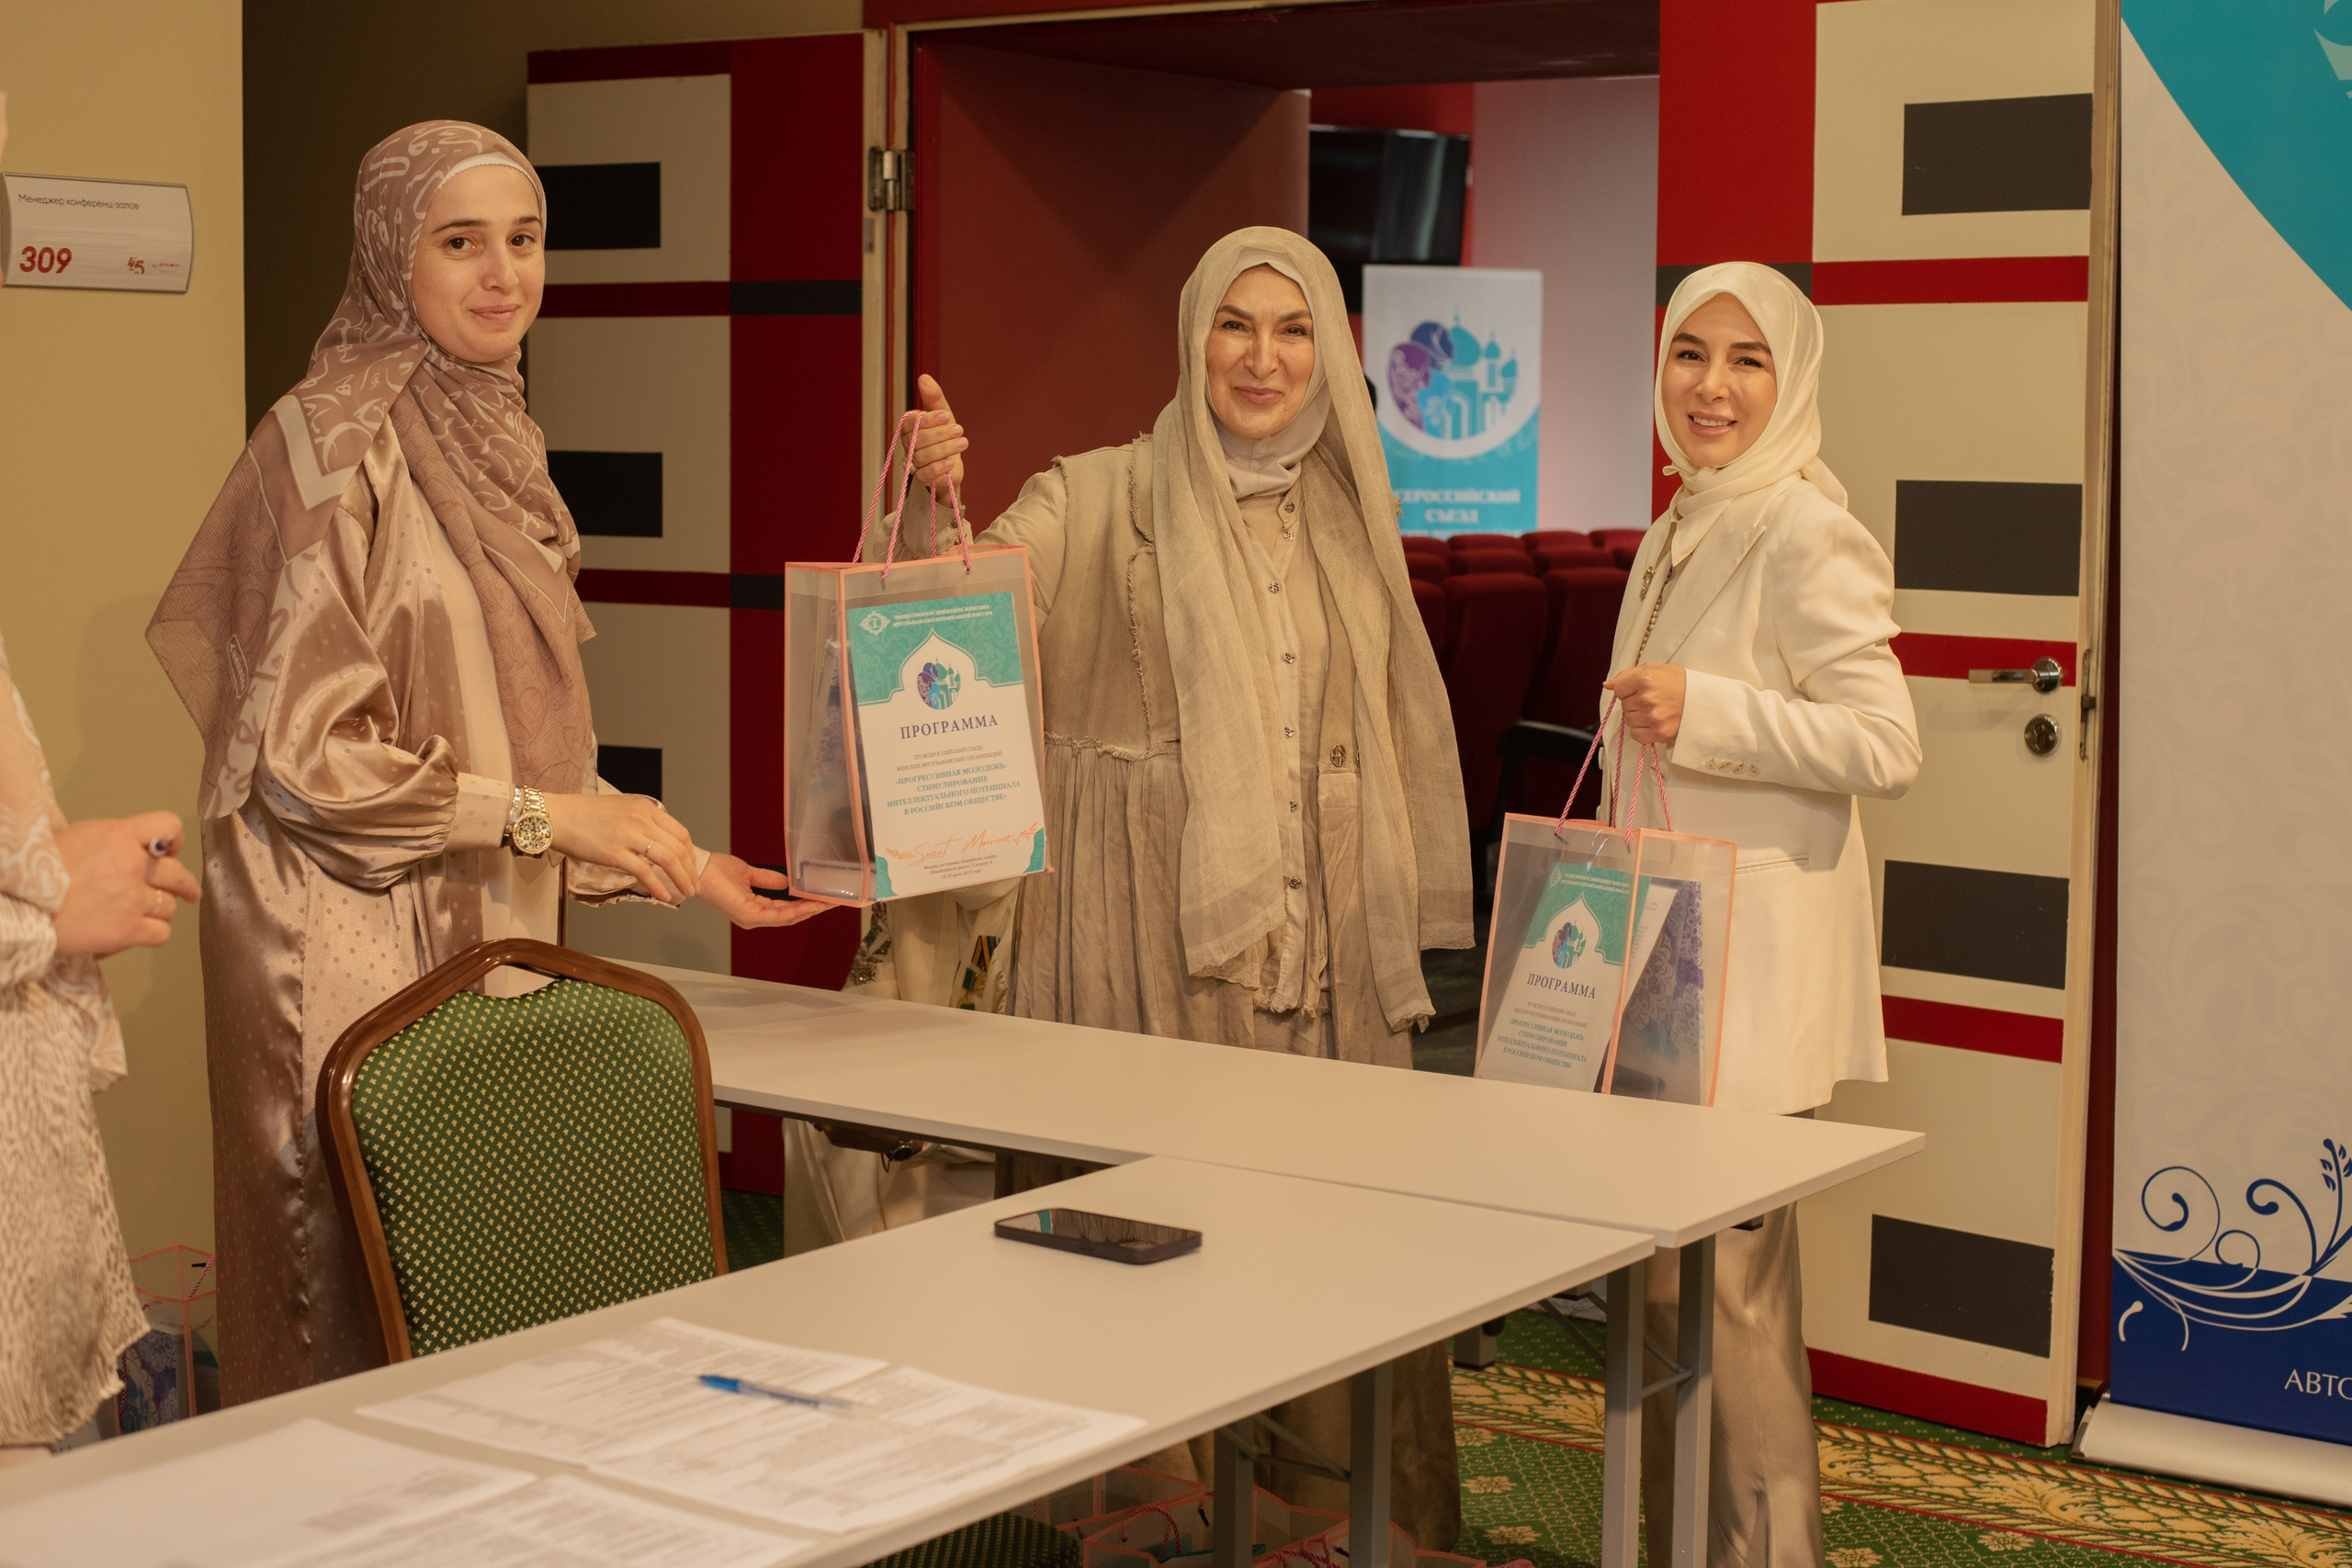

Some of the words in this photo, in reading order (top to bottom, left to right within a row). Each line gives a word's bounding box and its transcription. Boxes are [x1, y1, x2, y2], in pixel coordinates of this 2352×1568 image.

[18, 194, 64, 208] Менеджер
[66, 197, 140, 210] конференц-залов
[19, 245, 73, 274] 309
[1392, 488, 1521, 504] СЕРОССИЙСКИЙ
[899, 714, 999, 739] ПРОГРАММА
[896, 762, 922, 772] ЖЕНСКИХ
[922, 757, 966, 768] МУСУЛЬМАНСКИХ
[966, 750, 1002, 761] ОРГАНИЗАЦИЙ
[922, 747, 967, 759] ВСЕРОССИЙСКИЙ
[917, 775, 989, 792] СТИМУЛИРОВАНИЕ
[887, 788, 969, 807] ИНТЕЛЛЕКТУАЛЬНОГО
[969, 781, 1021, 795] ПОТЕНЦИАЛА
[910, 801, 963, 814] РОССИЙСКОМ
[910, 834, 964, 866] Sweet
[1526, 973, 1596, 999] ПРОГРАММА
[1519, 1031, 1568, 1047] СТИМУЛИРОВАНИЕ
[1507, 1047, 1543, 1062] РОССИЙСКОМ
[1551, 1048, 1587, 1063] ПОТЕНЦИАЛА
